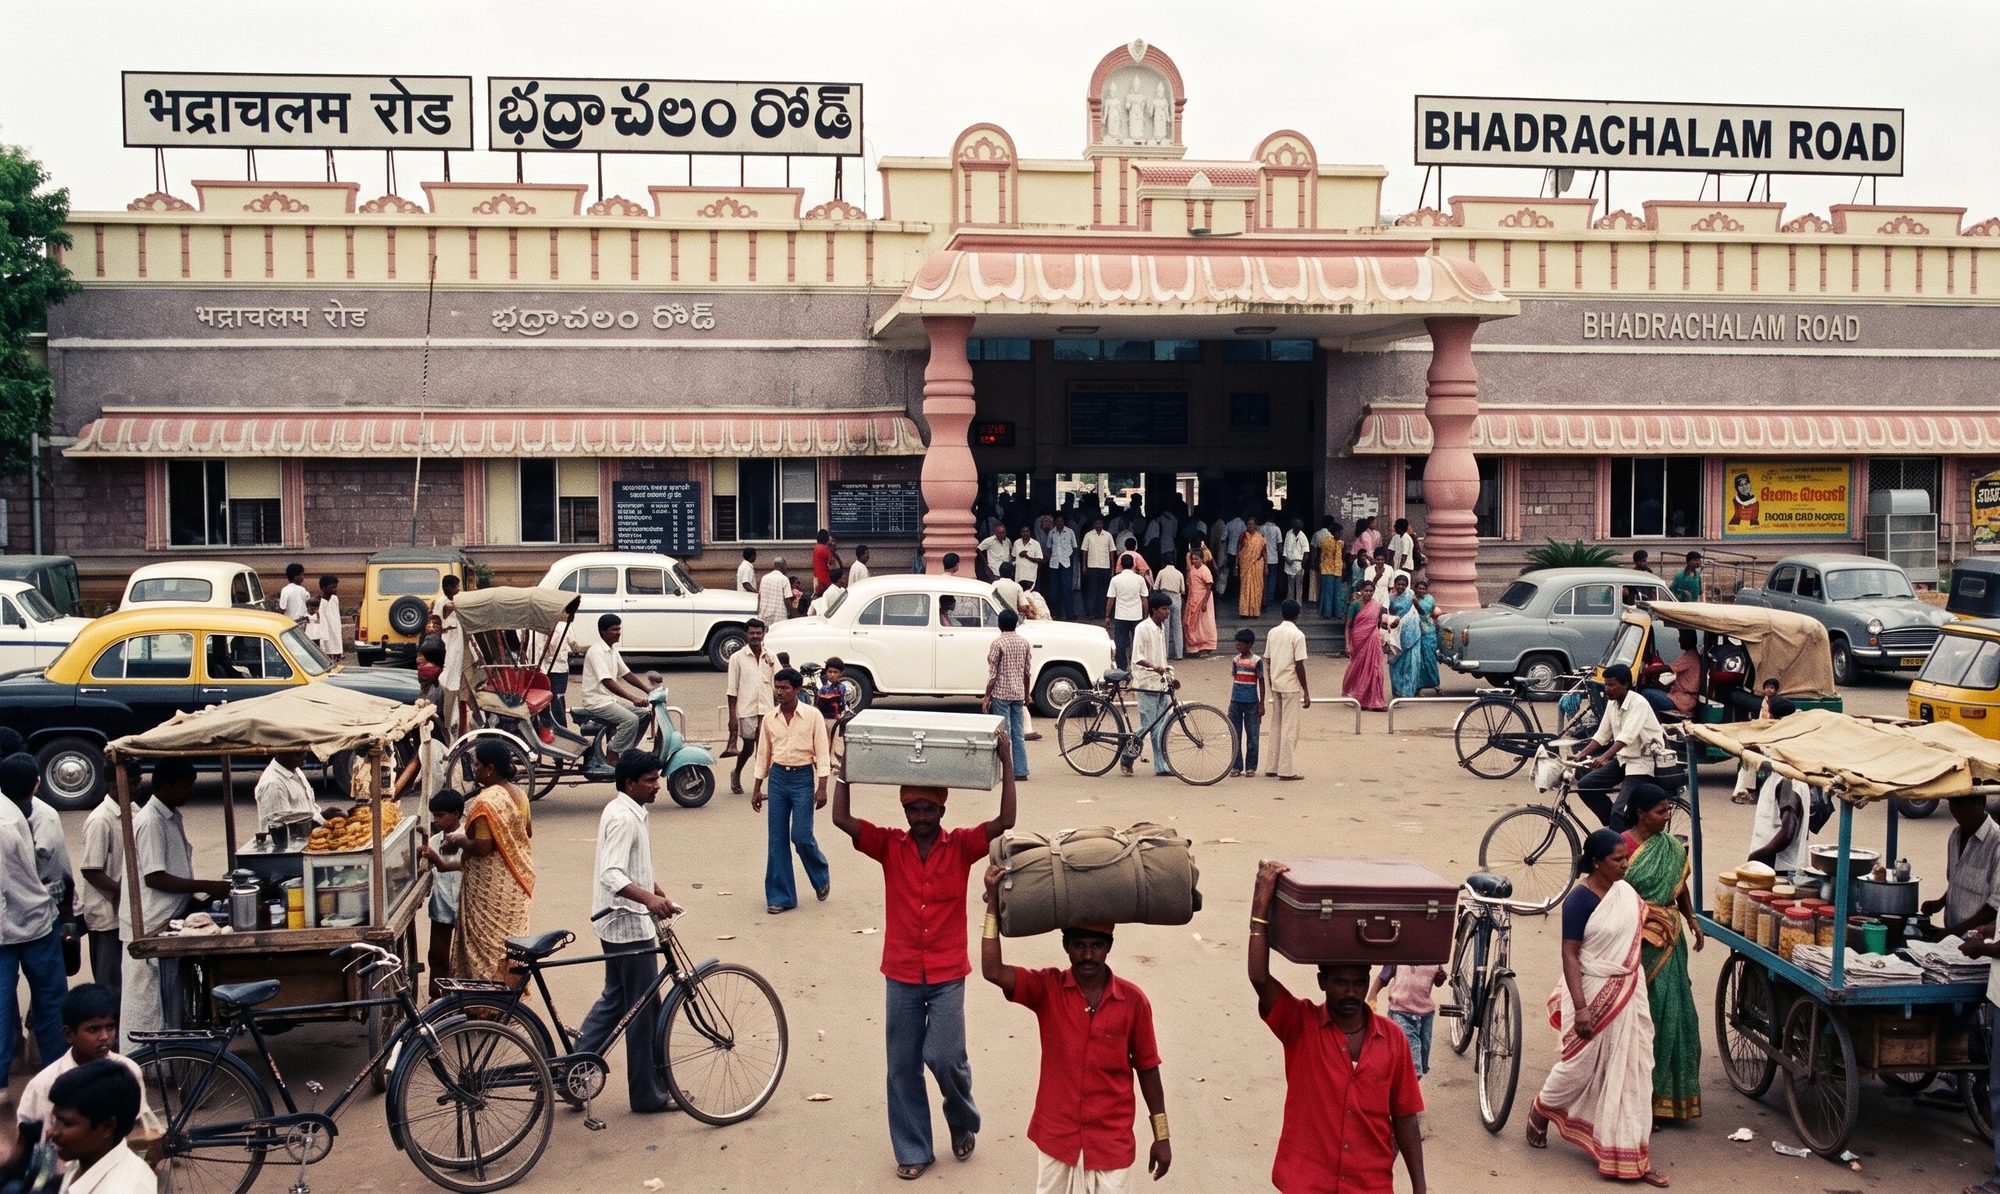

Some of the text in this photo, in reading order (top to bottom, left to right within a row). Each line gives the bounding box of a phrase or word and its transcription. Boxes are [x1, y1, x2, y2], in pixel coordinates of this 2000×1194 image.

[144, 77, 453, 135] भद्राचलम रोड
[498, 81, 852, 149] భద్రాచలం రోడ్
[1424, 111, 1896, 162] BHADRACHALAM ROAD
[195, 299, 368, 328] भद्राचलम रोड
[492, 305, 639, 336] భద్రాచలం
[1583, 311, 1861, 341] BHADRACHALAM ROAD
